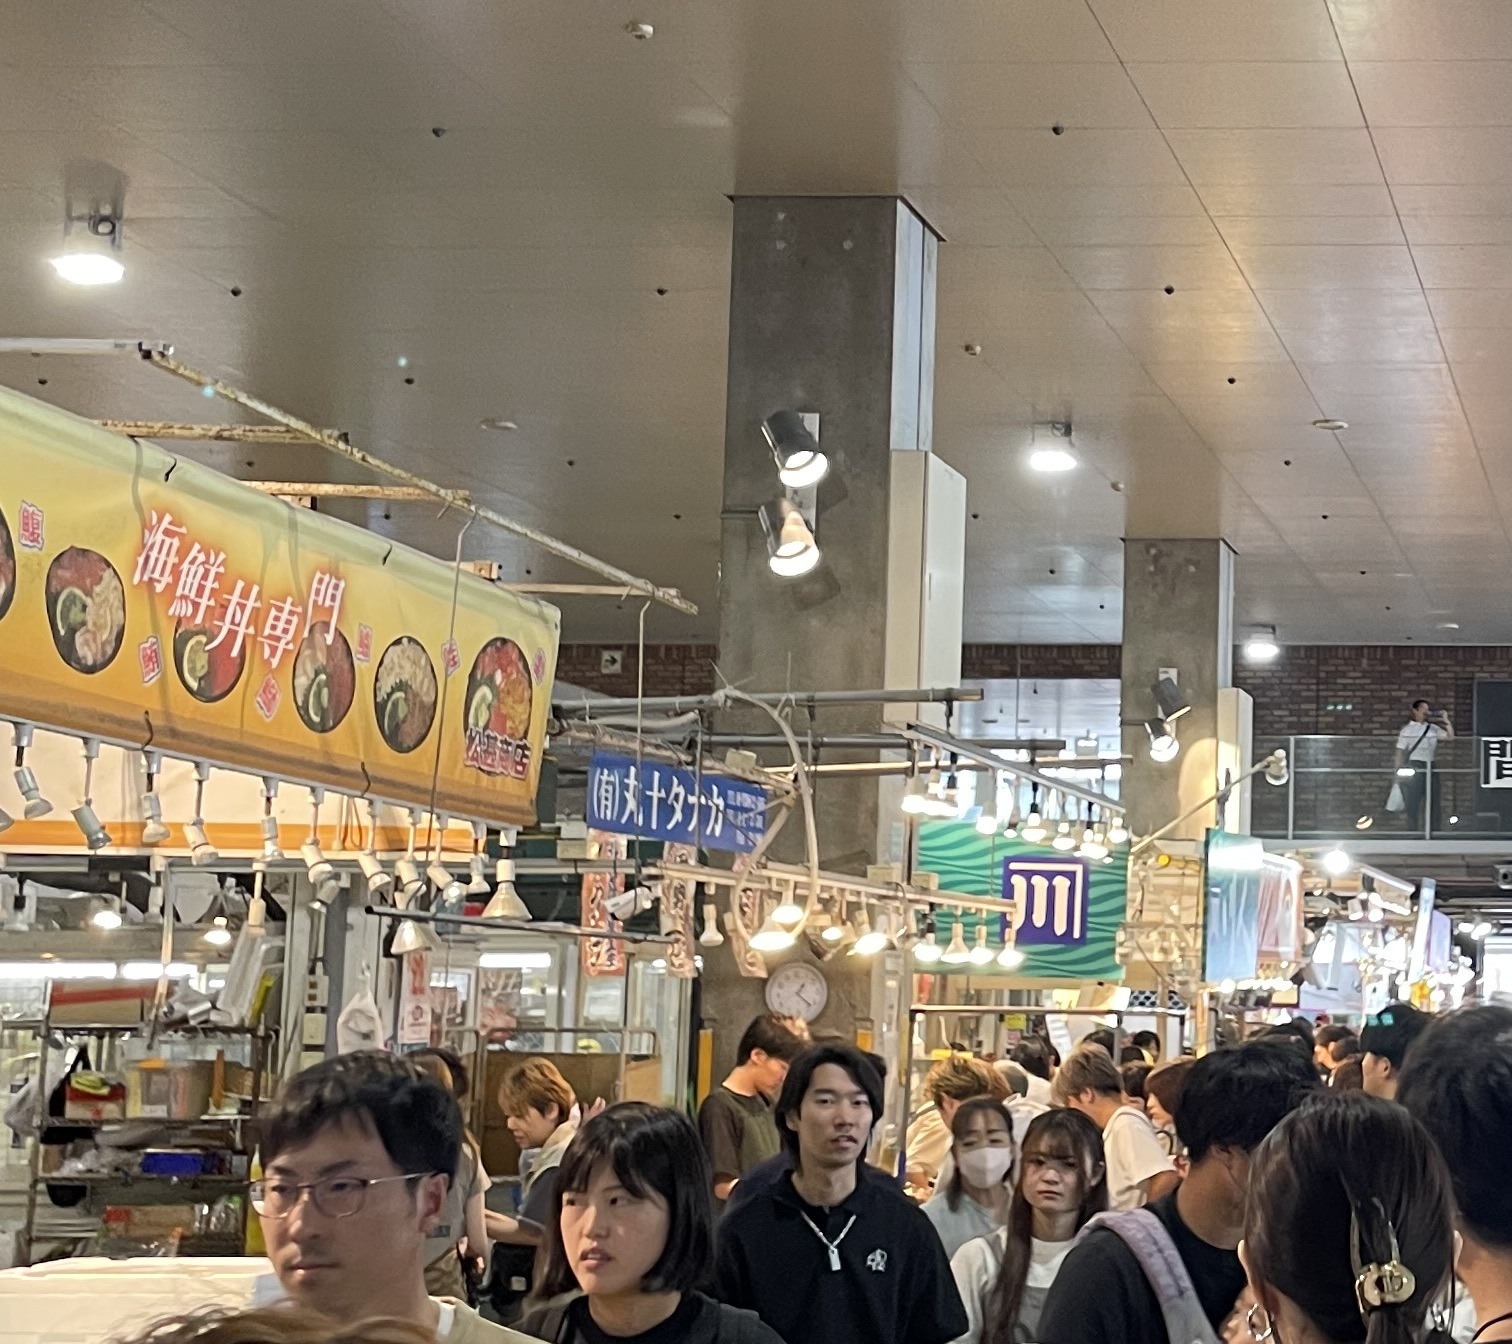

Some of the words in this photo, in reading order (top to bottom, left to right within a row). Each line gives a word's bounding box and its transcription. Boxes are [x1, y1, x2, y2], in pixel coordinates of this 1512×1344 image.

[133, 510, 345, 669] 海鮮丼専門
